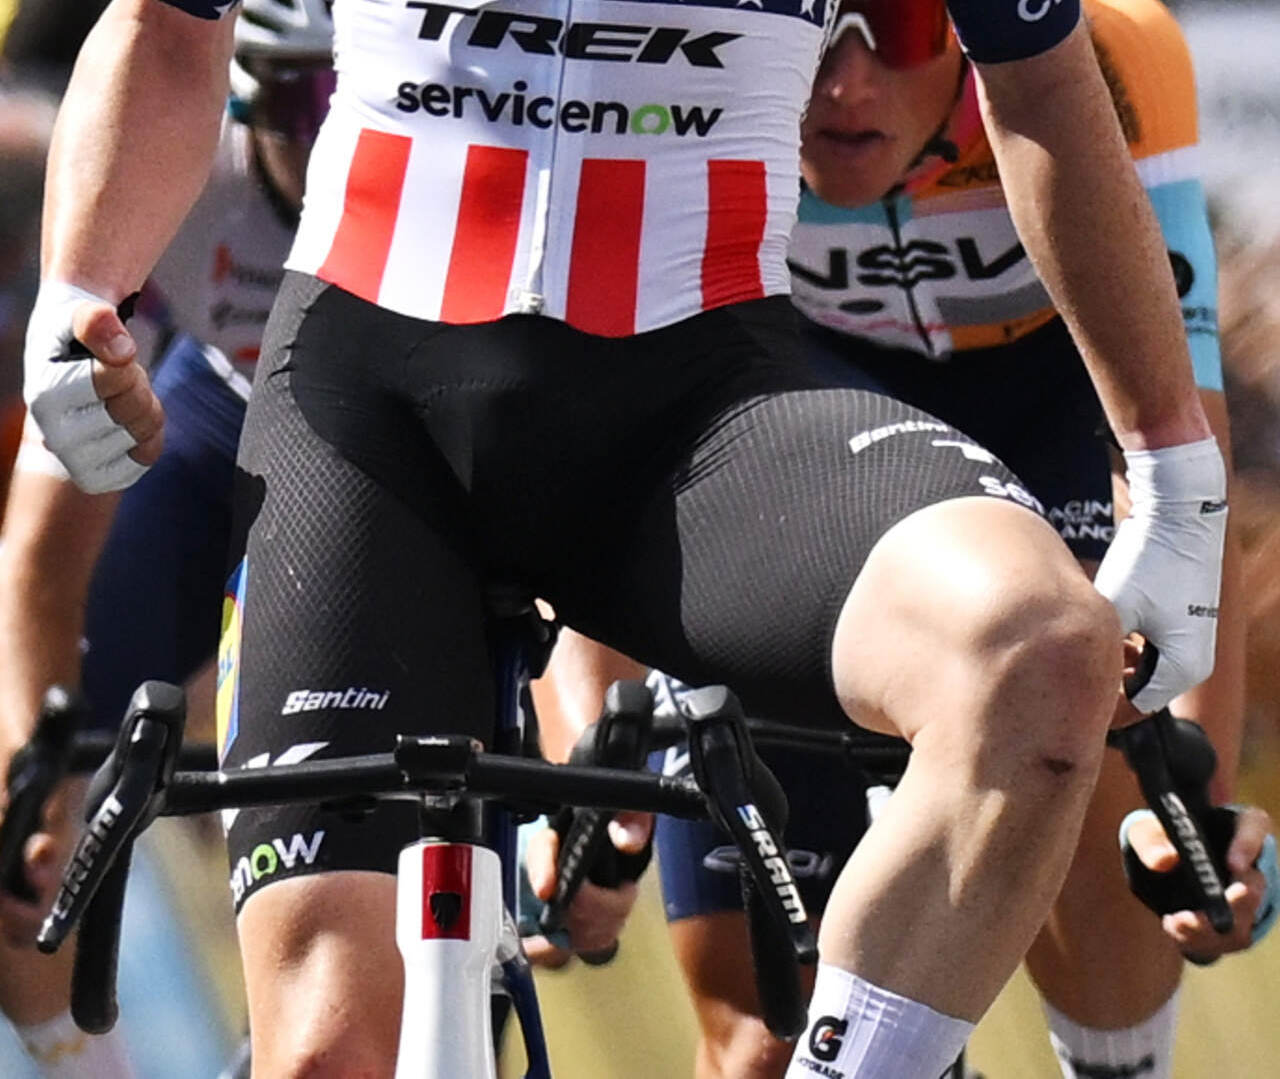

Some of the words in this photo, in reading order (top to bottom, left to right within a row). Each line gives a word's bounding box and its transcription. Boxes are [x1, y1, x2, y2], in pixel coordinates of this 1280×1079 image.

[405, 0, 745, 69] TREK
[396, 81, 724, 137] servicenow
[282, 687, 391, 715] Santini
[737, 803, 808, 924] SRAM
